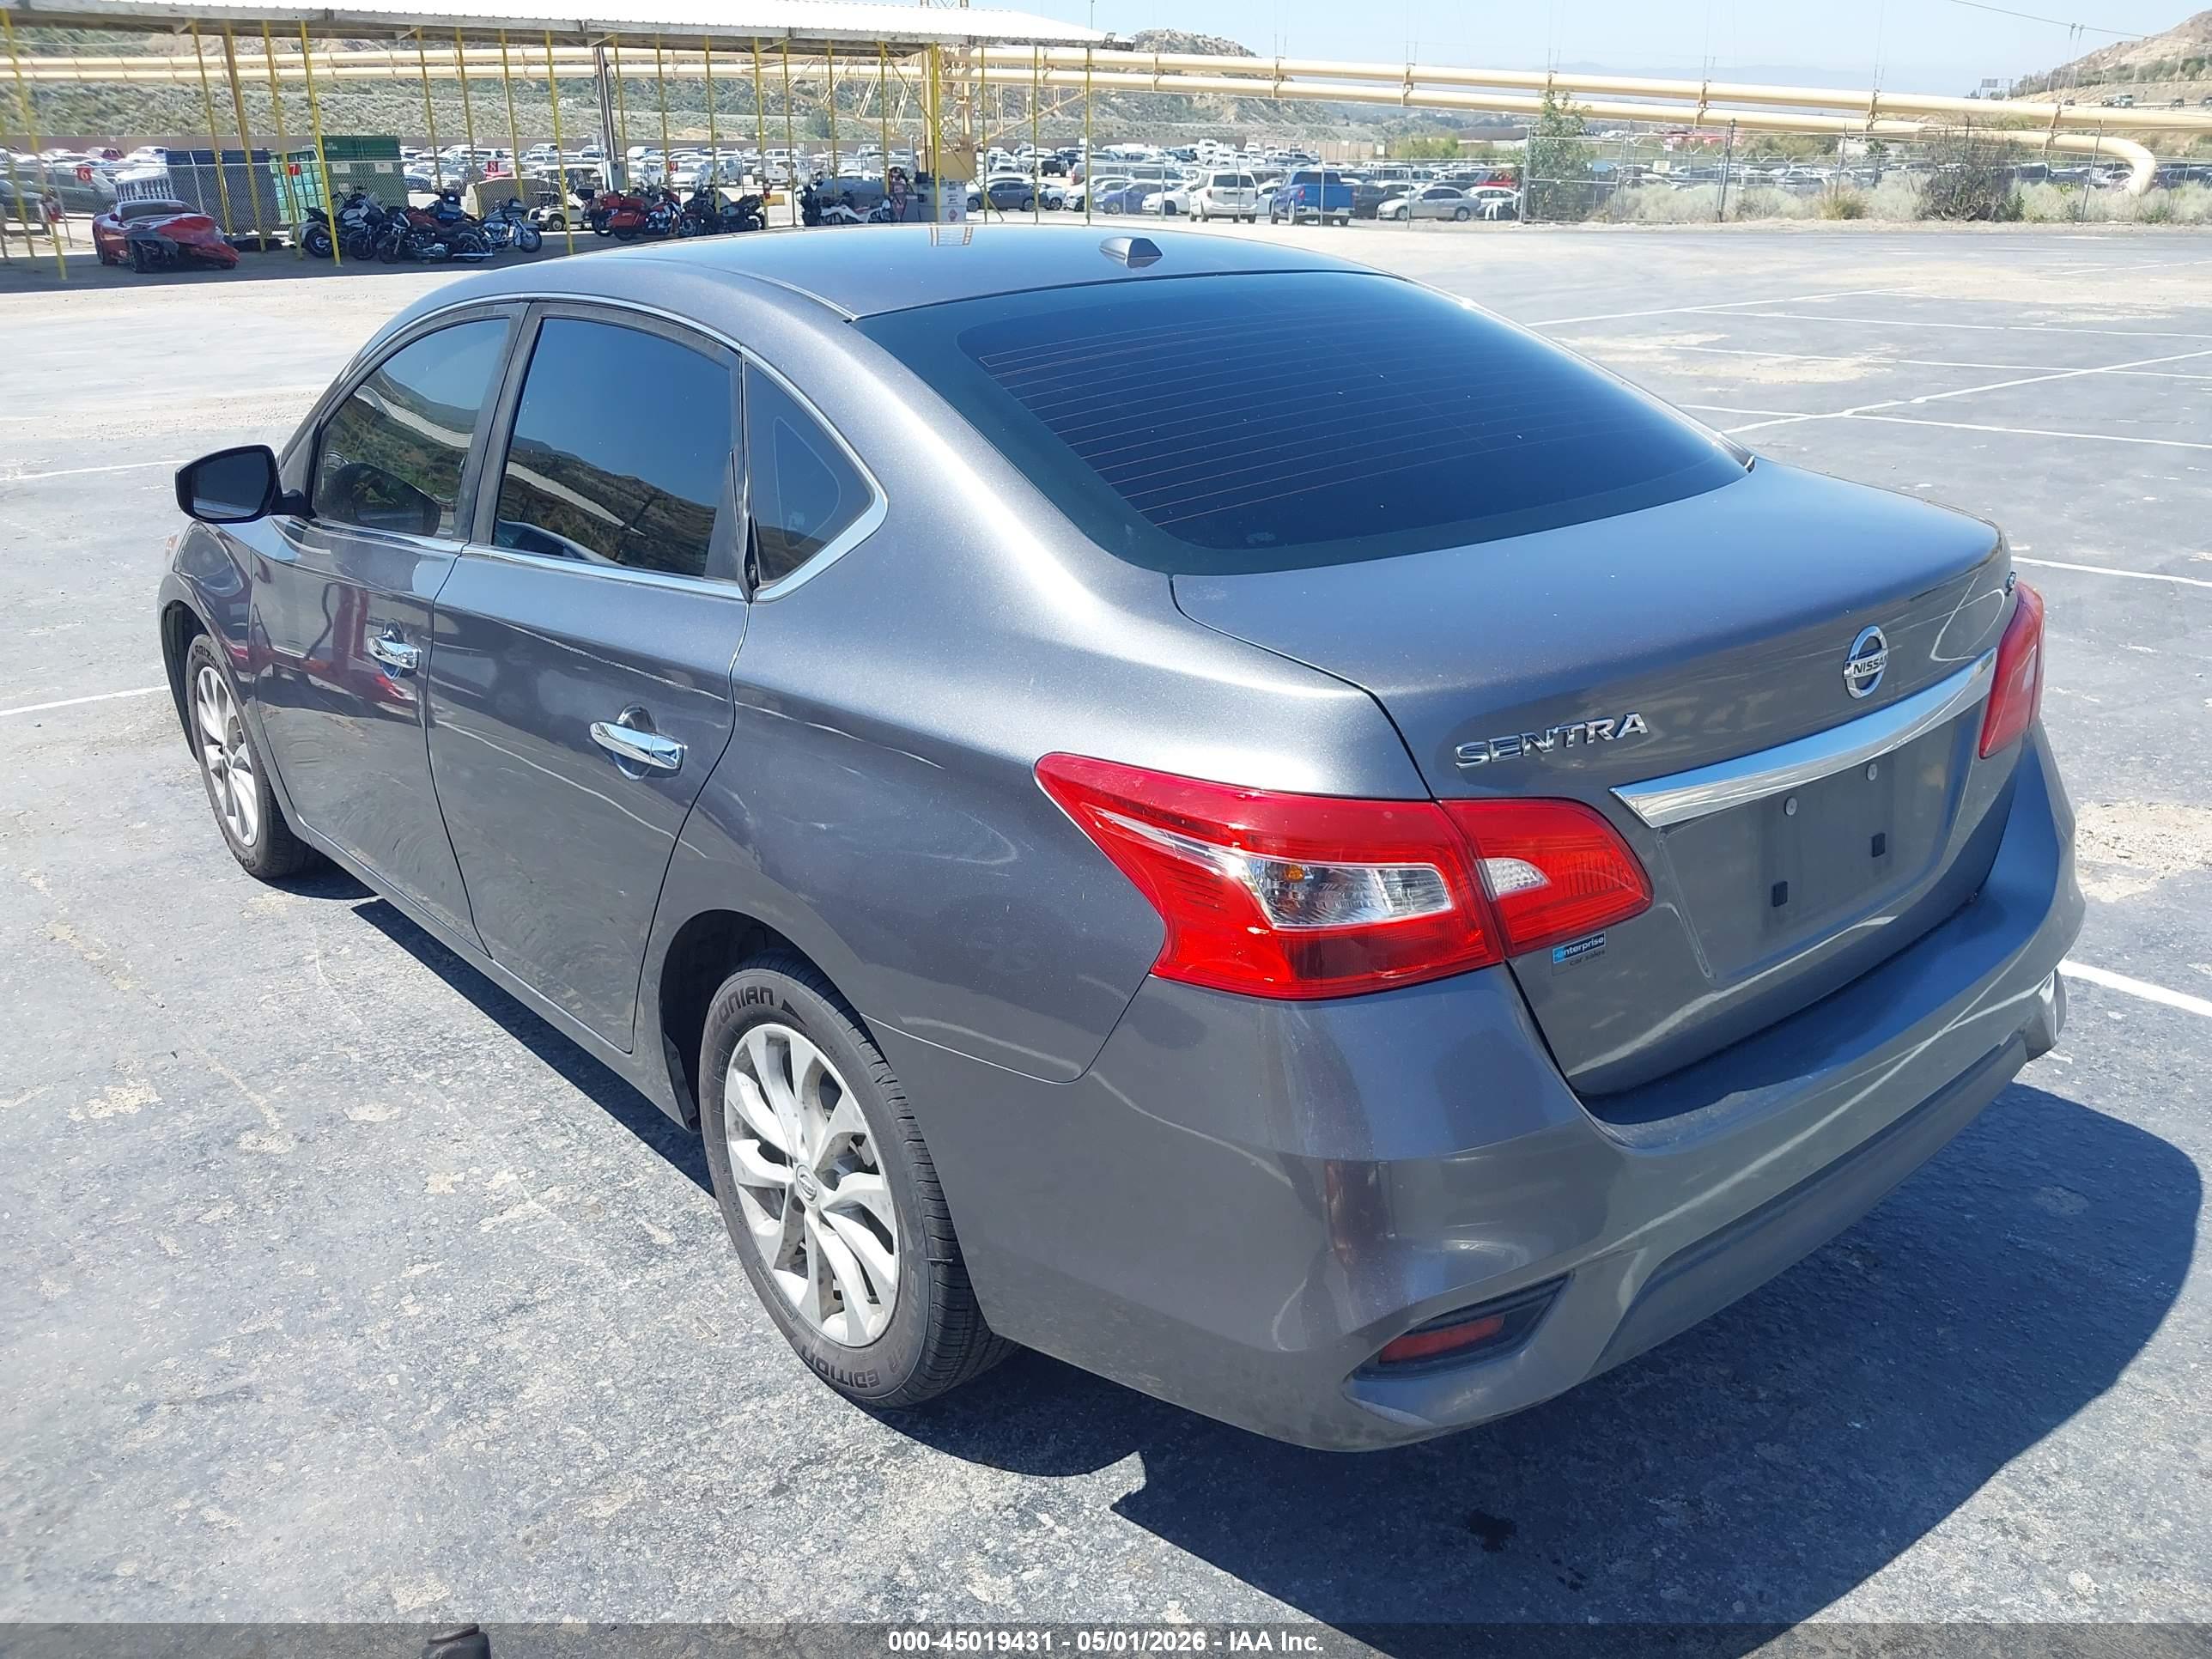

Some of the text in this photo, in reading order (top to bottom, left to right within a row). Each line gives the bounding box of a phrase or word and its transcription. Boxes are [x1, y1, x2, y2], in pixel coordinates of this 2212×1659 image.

[289, 164, 295, 175] 7
[489, 161, 496, 172] 8
[81, 169, 88, 180] 6
[1455, 713, 1649, 769] SENTRA
[1555, 937, 1604, 957] enterprise
[801, 1345, 880, 1389] EDITION
